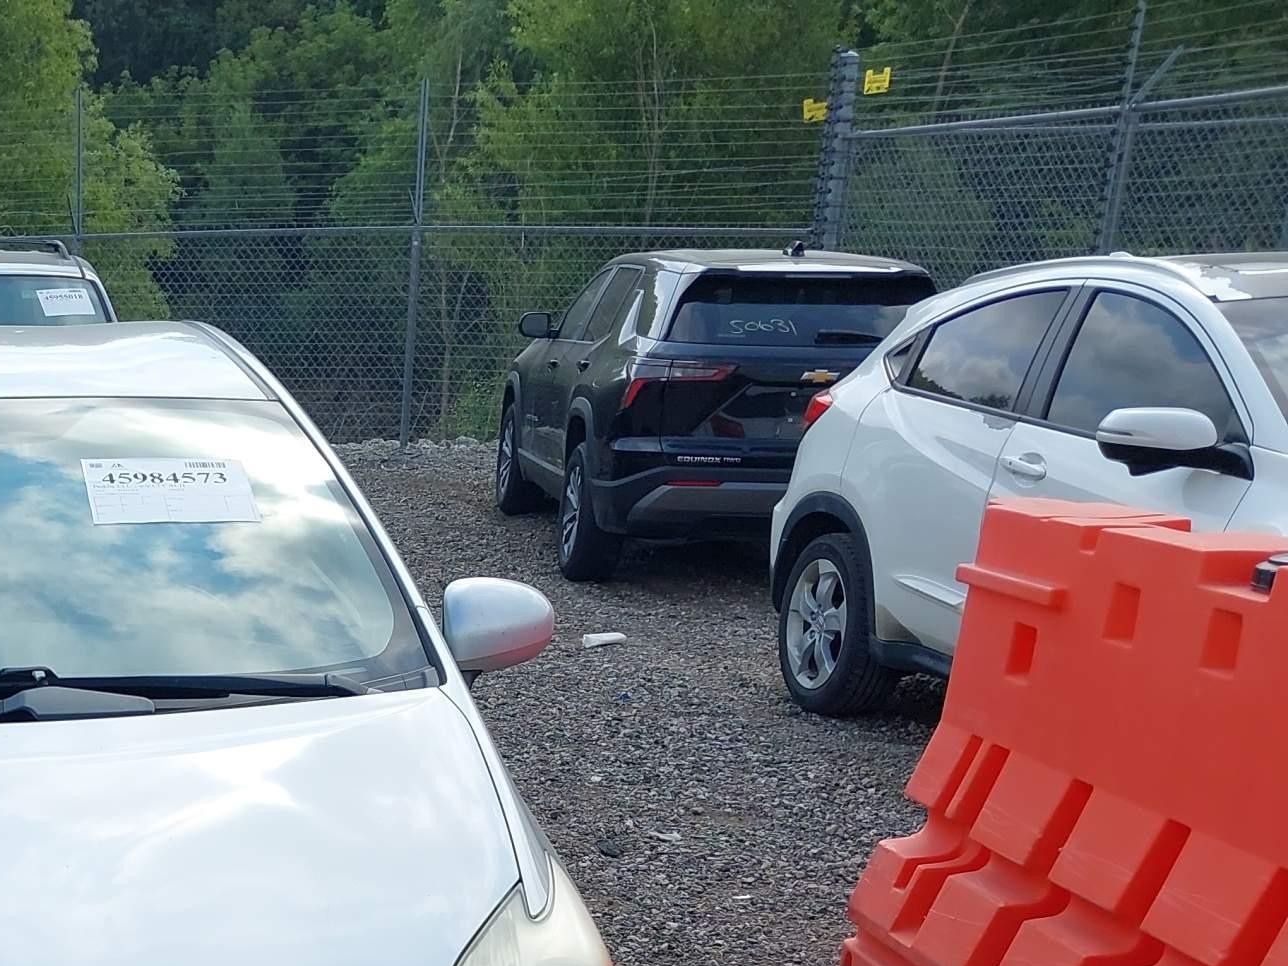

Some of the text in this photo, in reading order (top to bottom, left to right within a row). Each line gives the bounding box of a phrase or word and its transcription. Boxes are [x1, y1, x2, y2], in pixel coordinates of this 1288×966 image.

[729, 318, 797, 335] 50631
[677, 455, 722, 463] EQUINOX
[102, 472, 227, 484] 45984573
